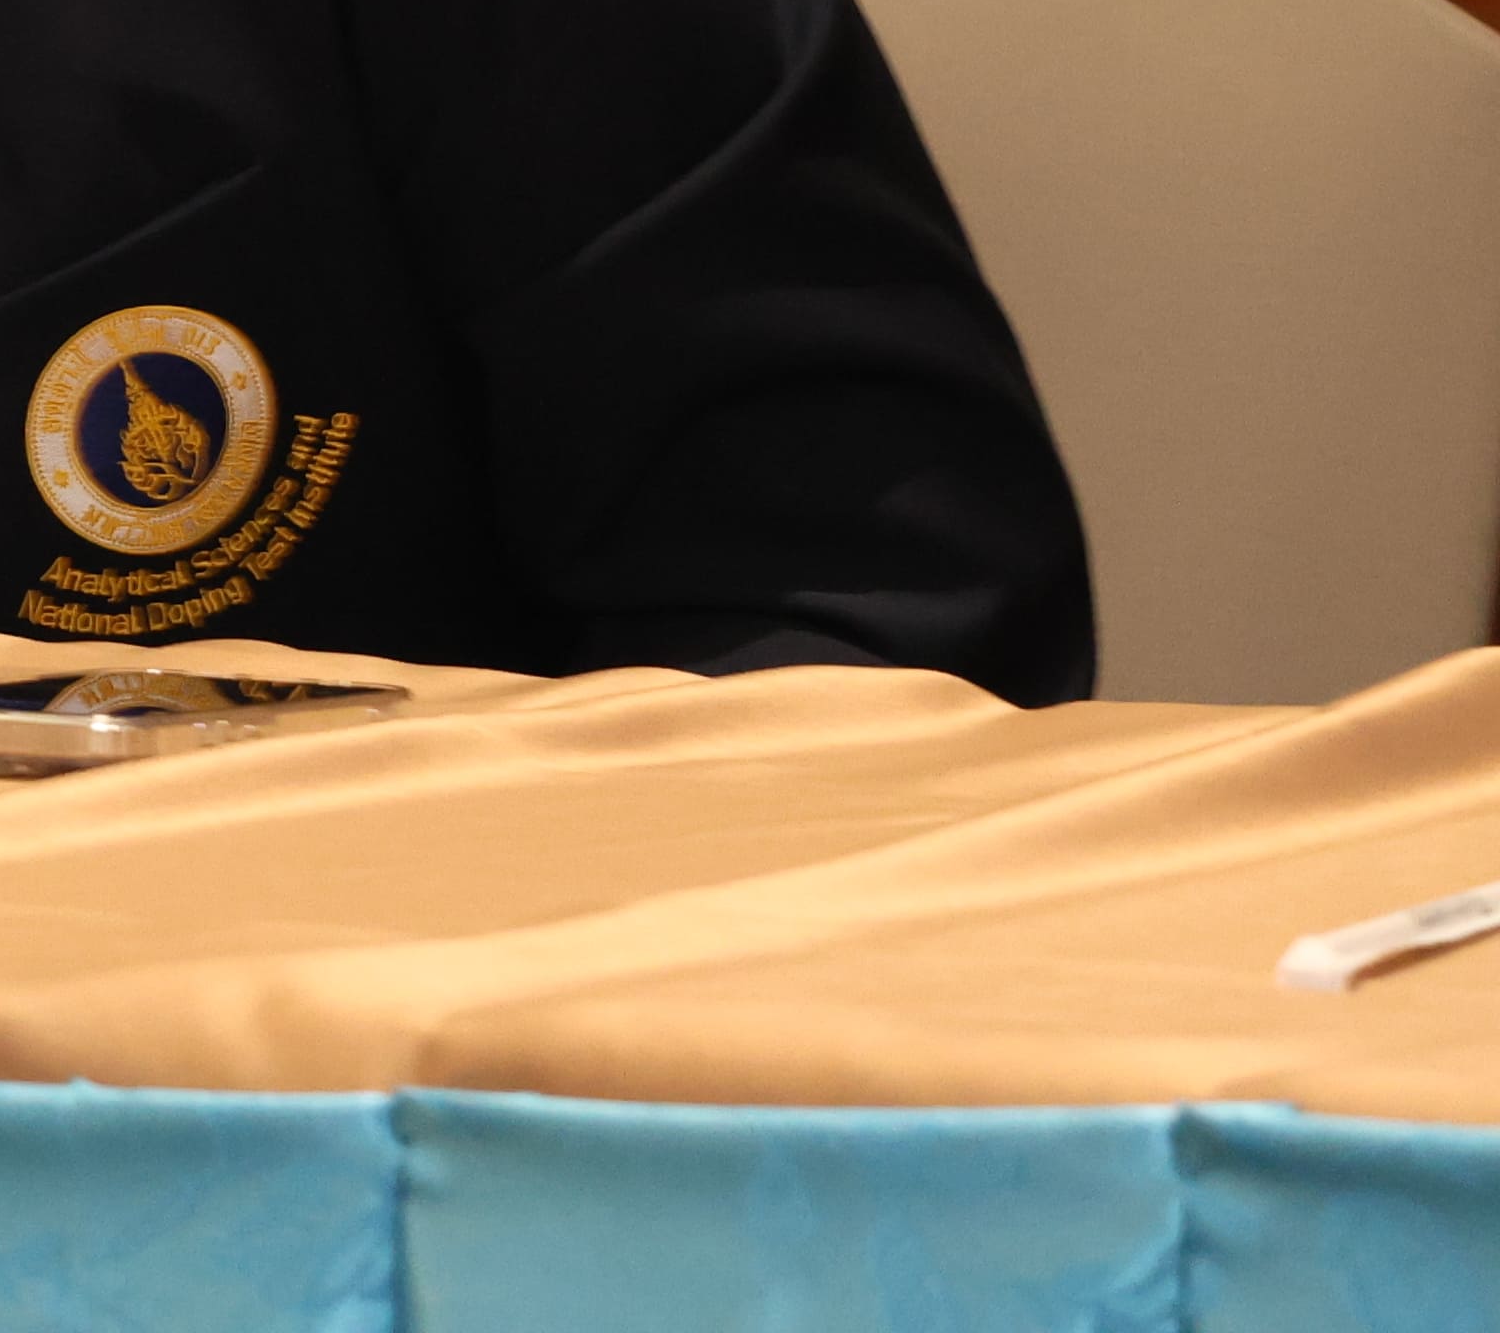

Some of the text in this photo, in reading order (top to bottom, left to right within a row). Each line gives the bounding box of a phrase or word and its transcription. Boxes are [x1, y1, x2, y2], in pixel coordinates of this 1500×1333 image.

[18, 412, 361, 635] National Doping Test Institute
[40, 414, 328, 603] Analytical Sciences and
